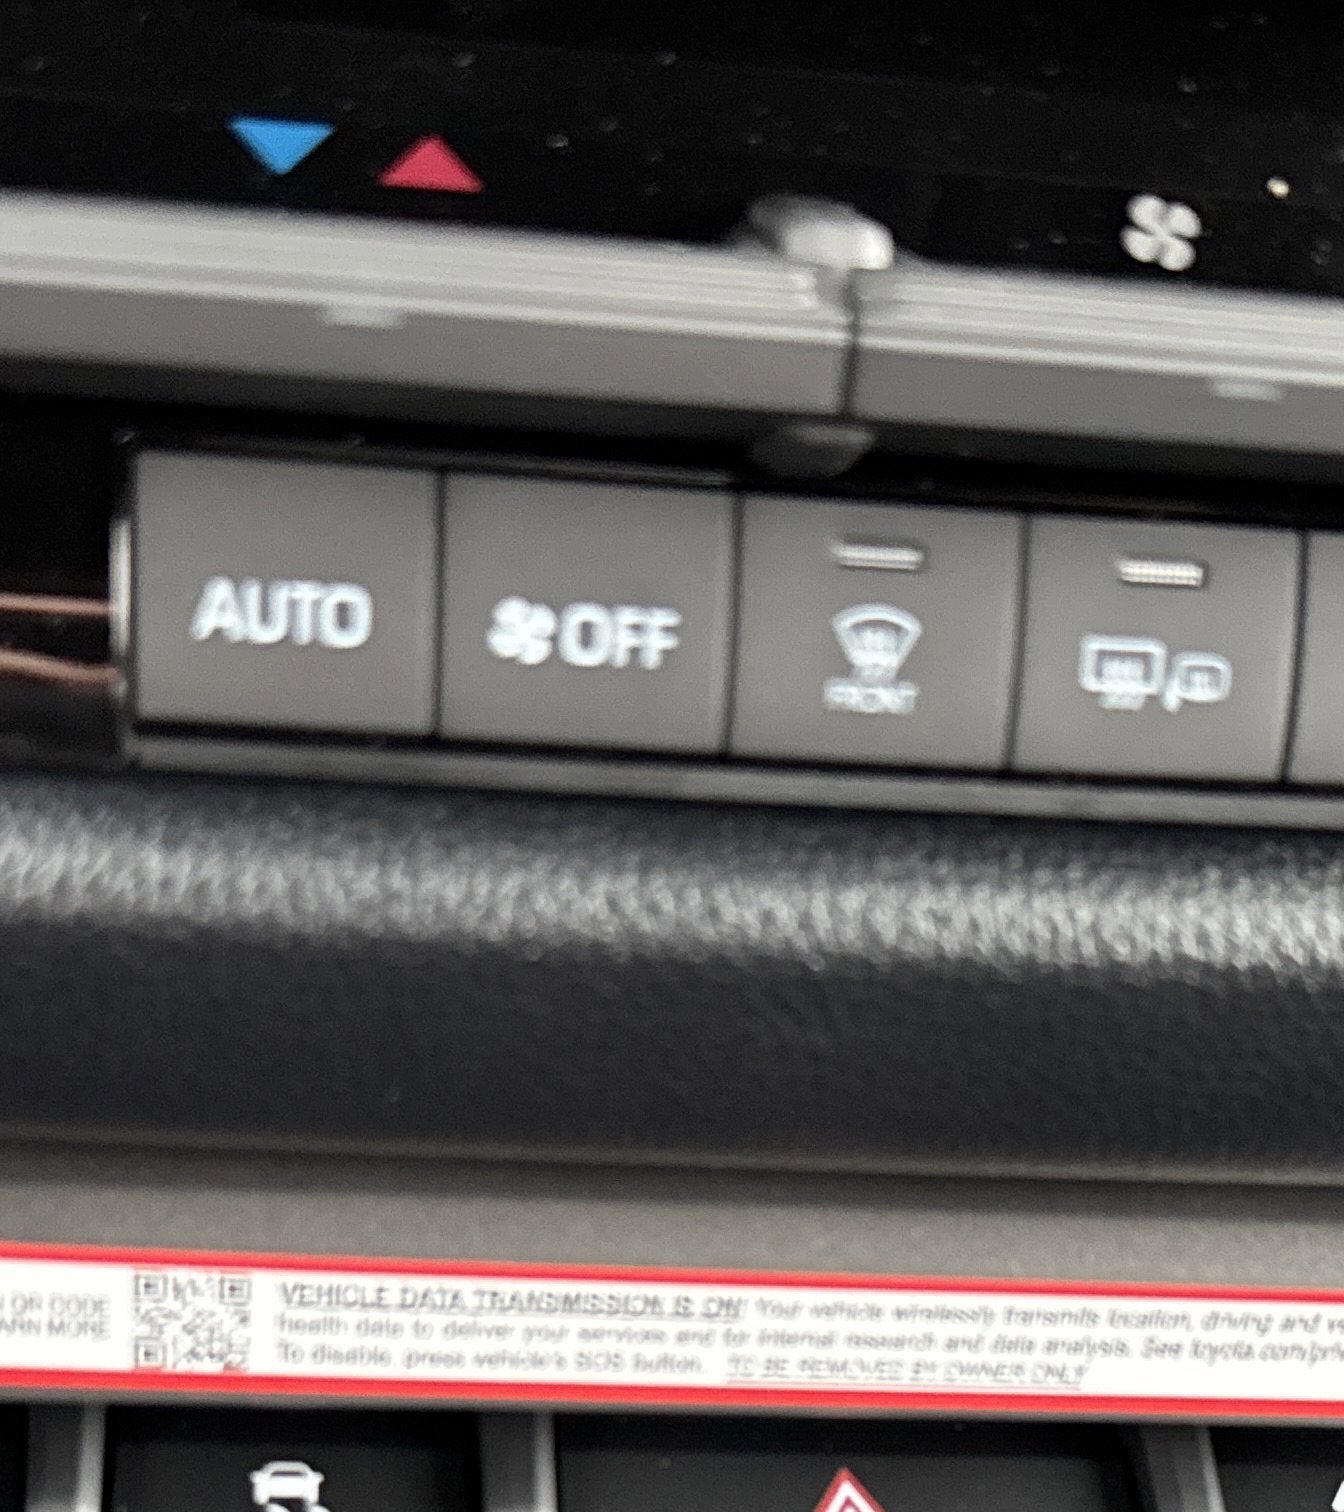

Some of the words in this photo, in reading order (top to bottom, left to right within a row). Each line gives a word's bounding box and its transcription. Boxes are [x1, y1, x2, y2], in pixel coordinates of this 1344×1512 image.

[190, 576, 374, 650] AUTO
[558, 602, 682, 669] OFF
[11, 1289, 43, 1316] QR
[48, 1291, 111, 1318] CODE
[278, 1282, 391, 1308] VEHICLE
[399, 1285, 465, 1310] DATA
[472, 1288, 666, 1316] TRANSMISSION
[669, 1295, 695, 1318] IS
[755, 1297, 803, 1321] Your
[809, 1301, 885, 1322] vehicle
[892, 1304, 996, 1332] wirelessly
[1002, 1305, 1102, 1329] transmits
[1200, 1310, 1274, 1337] driving
[1279, 1314, 1322, 1335] and
[47, 1317, 111, 1341] MORE
[276, 1312, 348, 1336] health
[355, 1317, 404, 1340] data
[412, 1318, 435, 1340] to
[441, 1319, 516, 1341] deliver
[522, 1324, 570, 1347] your
[576, 1325, 668, 1345] services
[674, 1328, 717, 1348] and
[722, 1327, 751, 1348] for
[757, 1328, 837, 1350] internal
[844, 1331, 938, 1352] research
[942, 1333, 985, 1354] and
[989, 1333, 1037, 1355] data
[1140, 1334, 1184, 1360] See
[276, 1338, 305, 1365] To
[402, 1347, 465, 1369] press
[574, 1350, 627, 1373] SOS
